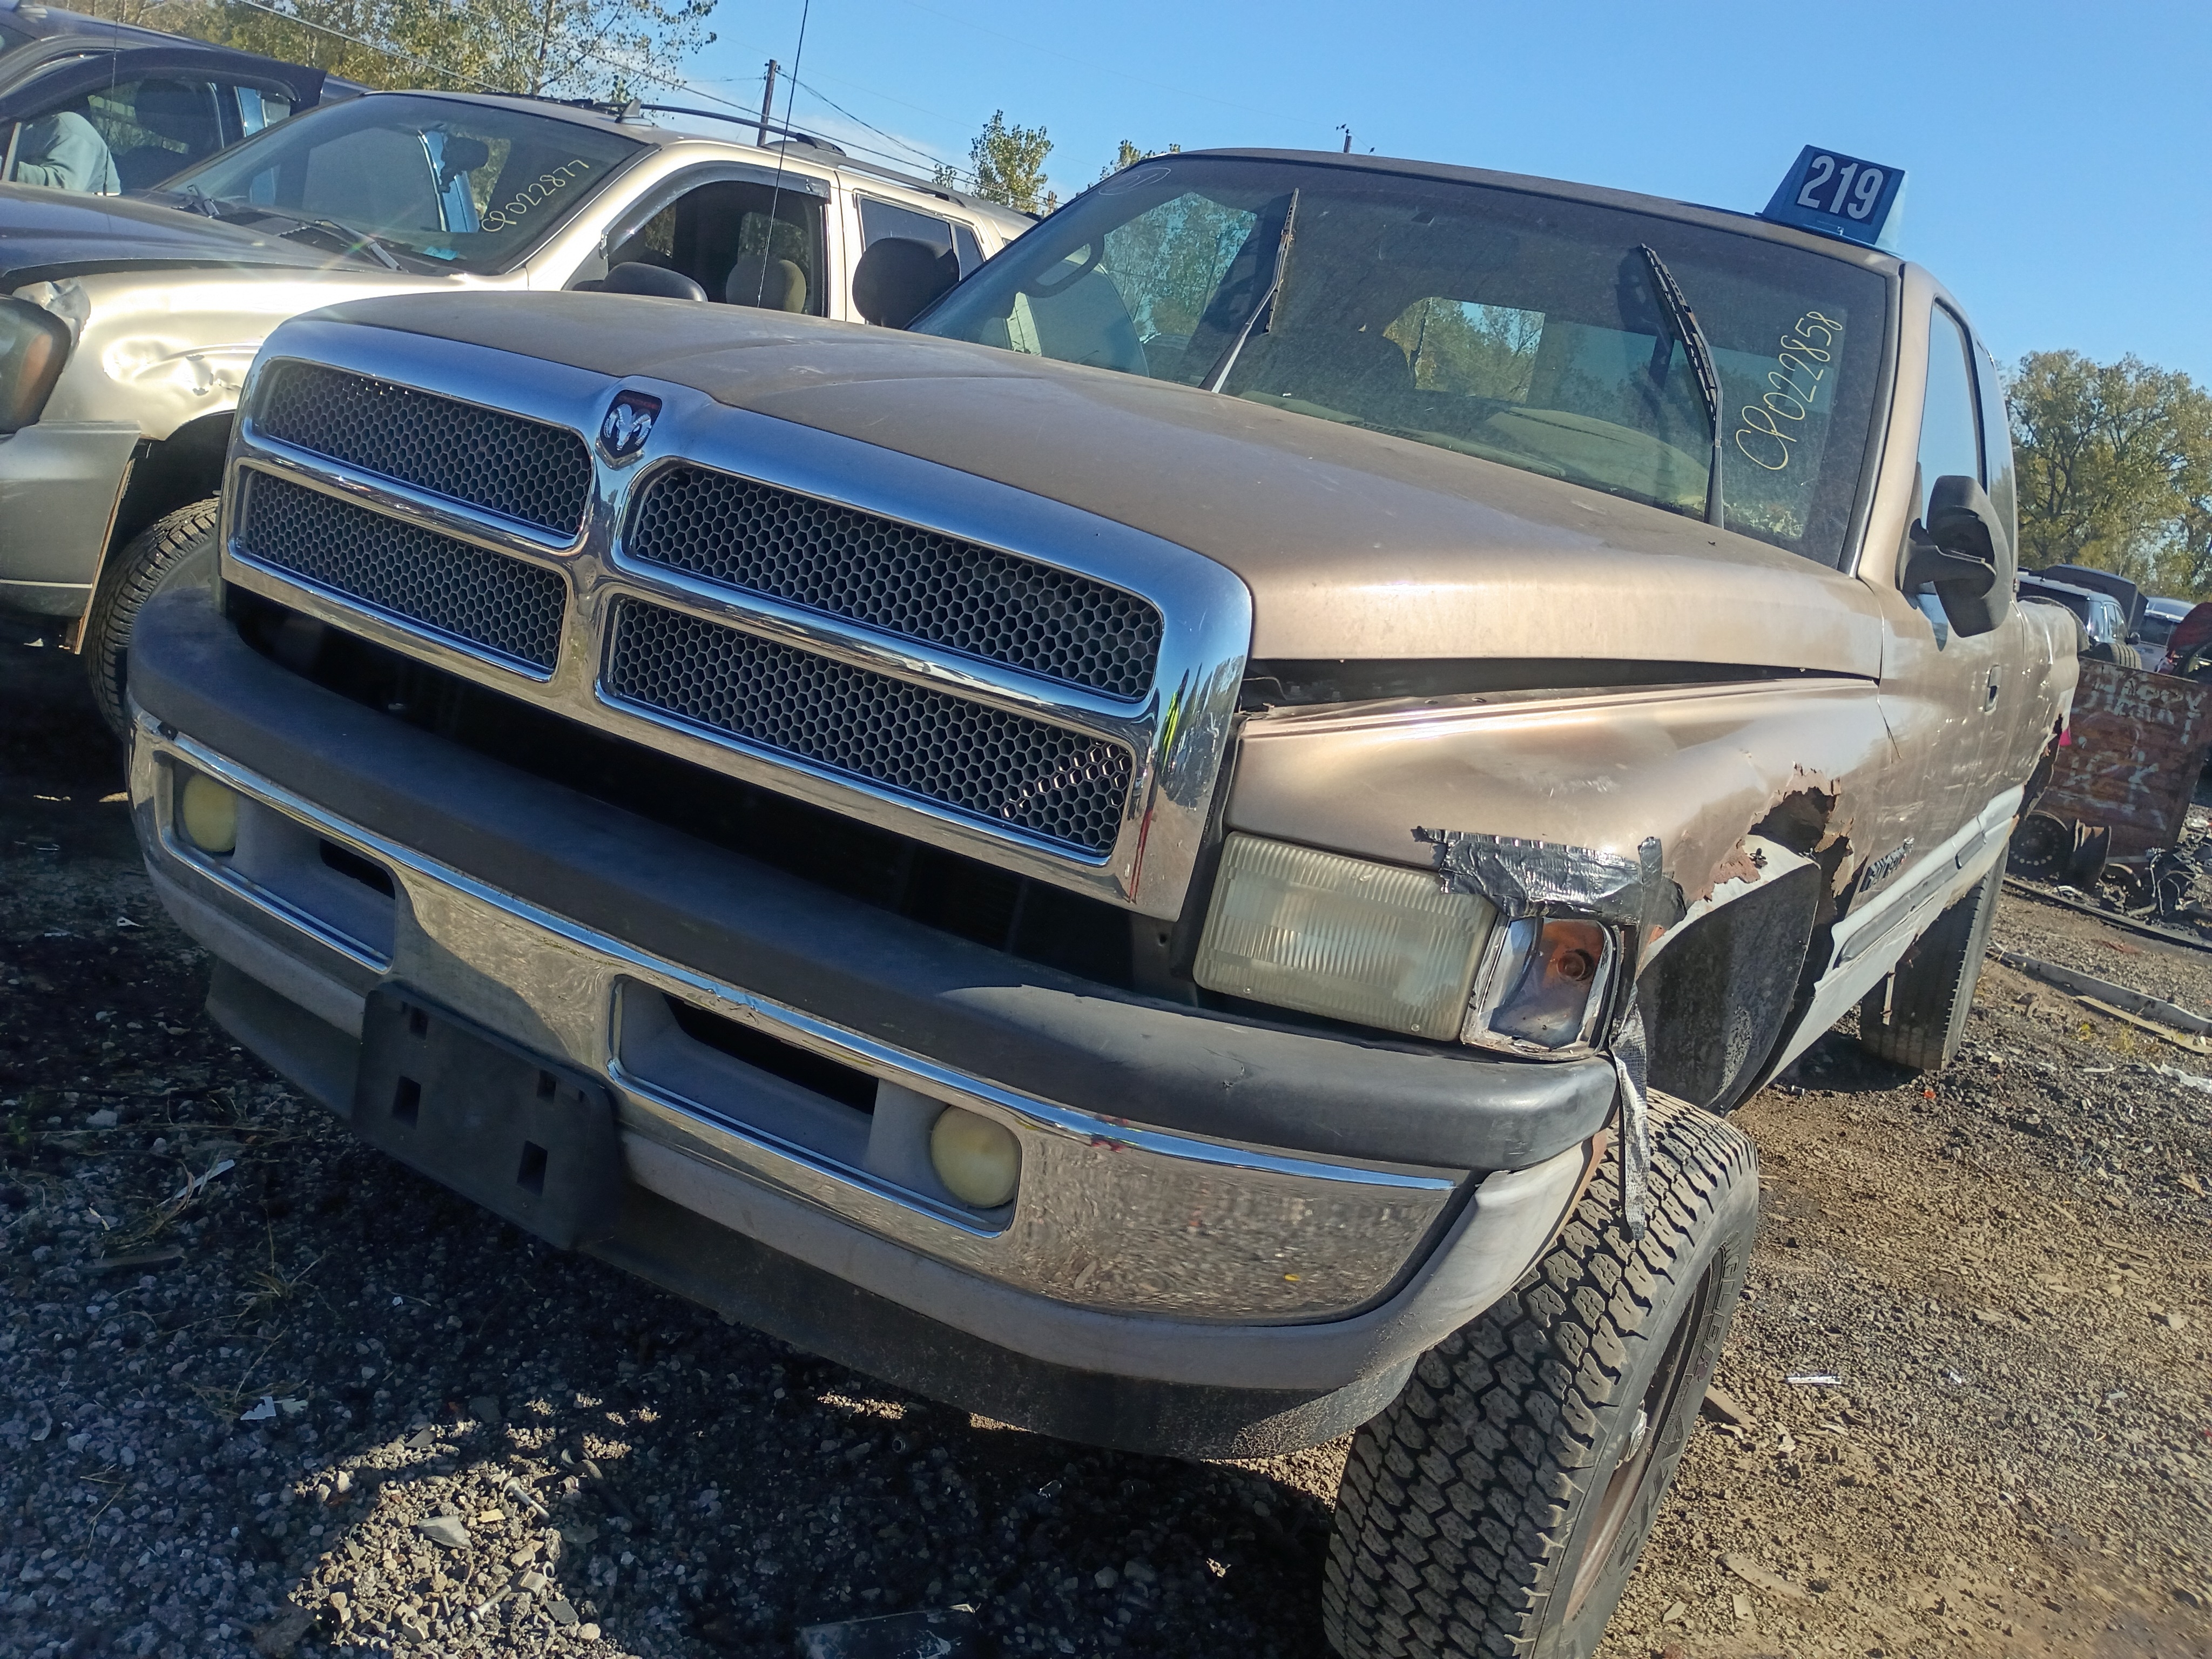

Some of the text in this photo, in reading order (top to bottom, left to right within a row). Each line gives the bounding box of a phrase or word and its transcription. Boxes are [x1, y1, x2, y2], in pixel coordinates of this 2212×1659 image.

[481, 159, 589, 232] CP022877
[1797, 155, 1884, 219] 219
[1735, 311, 1843, 470] CP022858
